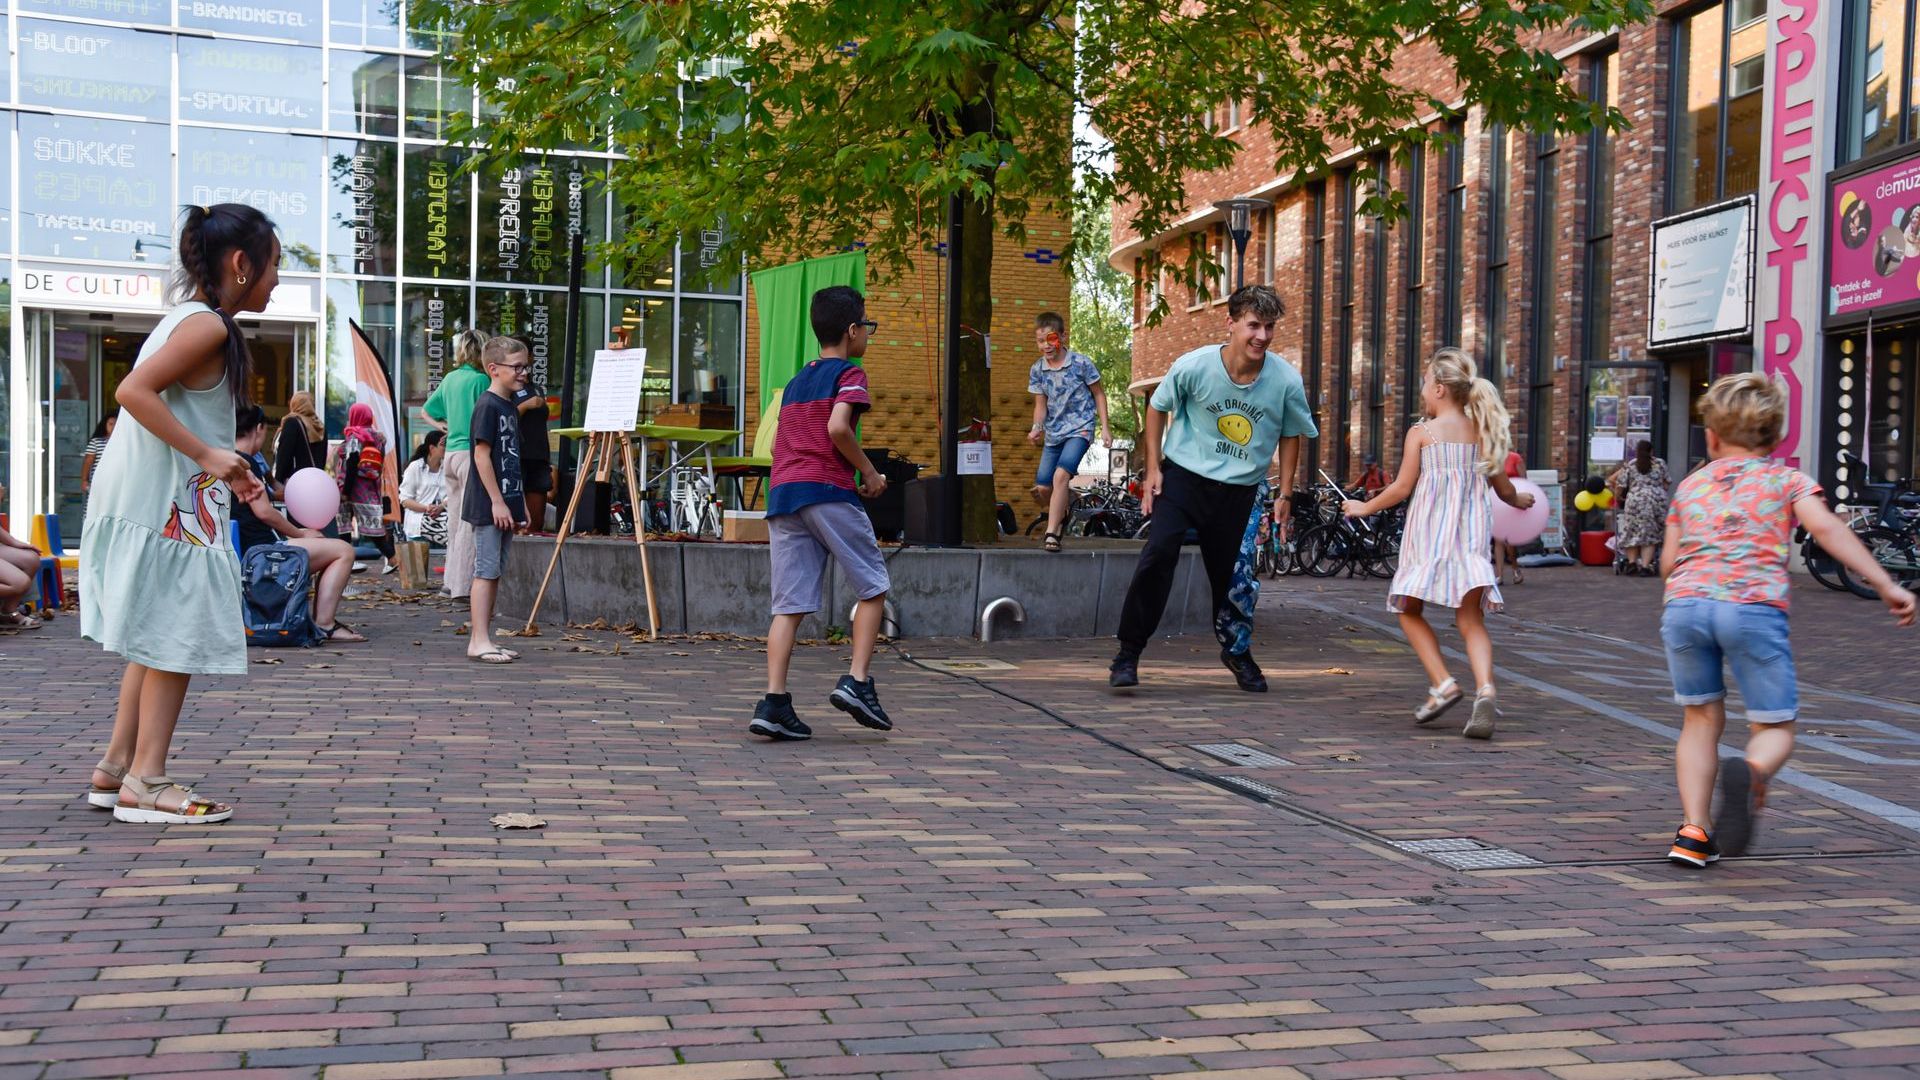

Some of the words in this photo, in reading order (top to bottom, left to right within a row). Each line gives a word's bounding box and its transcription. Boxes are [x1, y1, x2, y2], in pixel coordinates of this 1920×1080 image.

[193, 2, 307, 27] BRANDNETEL
[34, 137, 135, 168] SOKKE
[352, 155, 375, 260] WANTEN
[499, 167, 521, 269] SPREIEN
[34, 213, 157, 235] TAFELKLEDEN
[1681, 235, 1698, 246] VOOR
[1699, 233, 1707, 242] DE
[1708, 227, 1729, 239] KUNST
[1763, 0, 1818, 527] SPECTRU
[25, 273, 54, 291] DE
[1835, 280, 1861, 294] Ontdek
[1861, 277, 1872, 289] de
[1854, 292, 1862, 303] in
[1861, 287, 1883, 304] jezelf
[427, 299, 445, 398] BIBLIOTHE
[1206, 401, 1223, 416] THE
[1225, 398, 1264, 424] ORIGINAL
[1215, 441, 1249, 461] SMILEY
